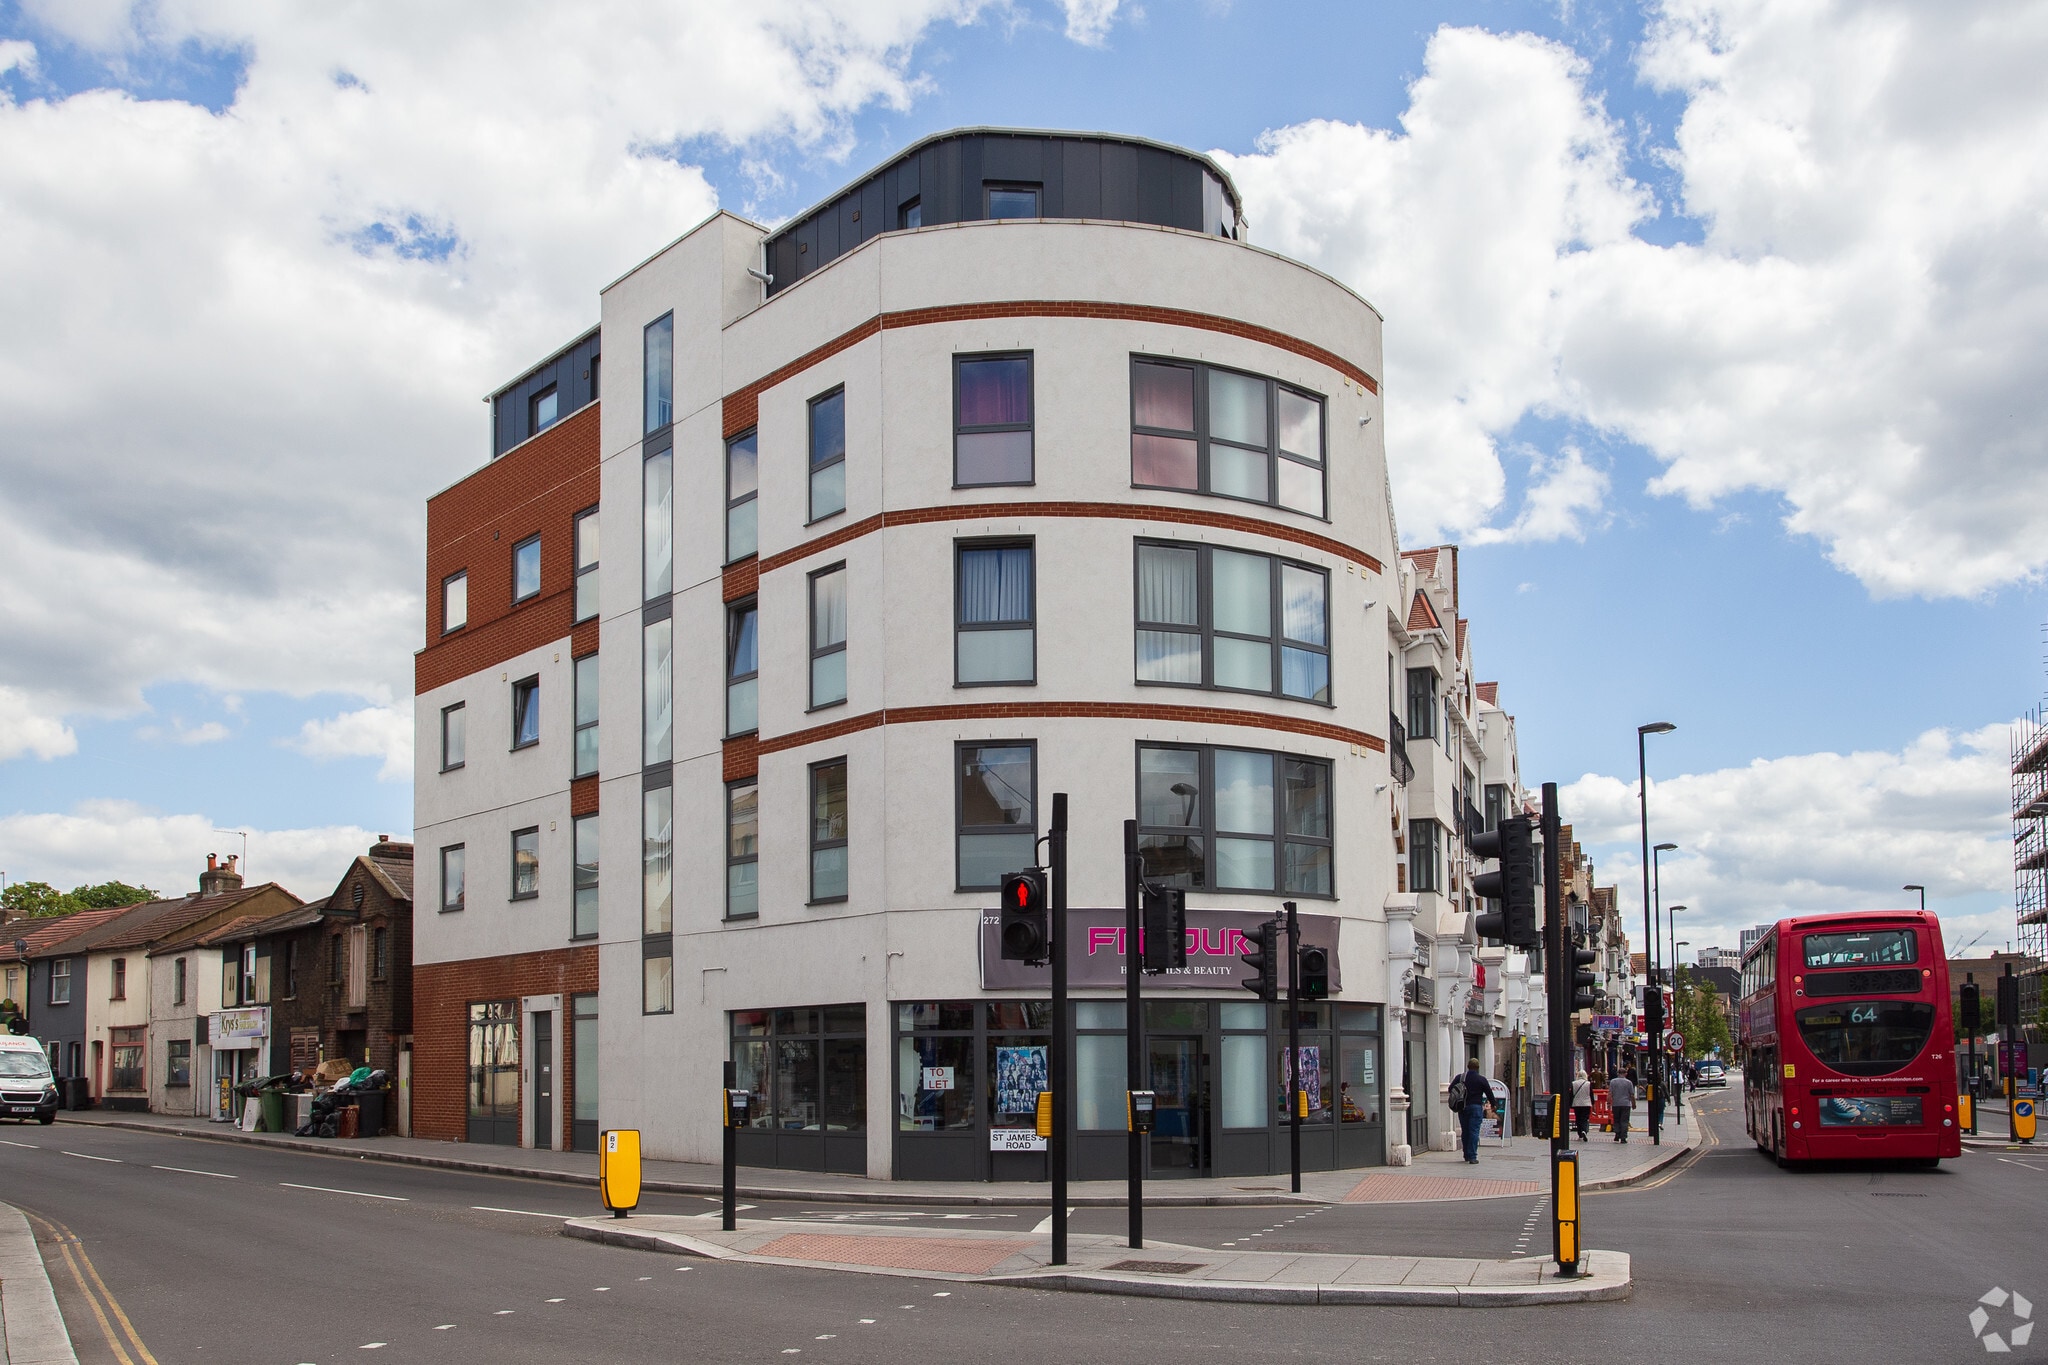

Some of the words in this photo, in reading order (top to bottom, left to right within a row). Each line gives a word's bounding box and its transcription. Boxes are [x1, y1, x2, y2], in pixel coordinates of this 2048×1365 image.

[983, 916, 1000, 925] 272
[1183, 967, 1191, 975] &
[1194, 967, 1232, 975] BEAUTY
[1851, 1007, 1878, 1023] 64
[221, 1013, 239, 1037] Krys's
[1670, 1037, 1682, 1046] 20
[929, 1068, 944, 1076] TO
[928, 1080, 949, 1089] LET
[992, 1133, 1003, 1142] ST
[1005, 1142, 1032, 1150] ROAD
